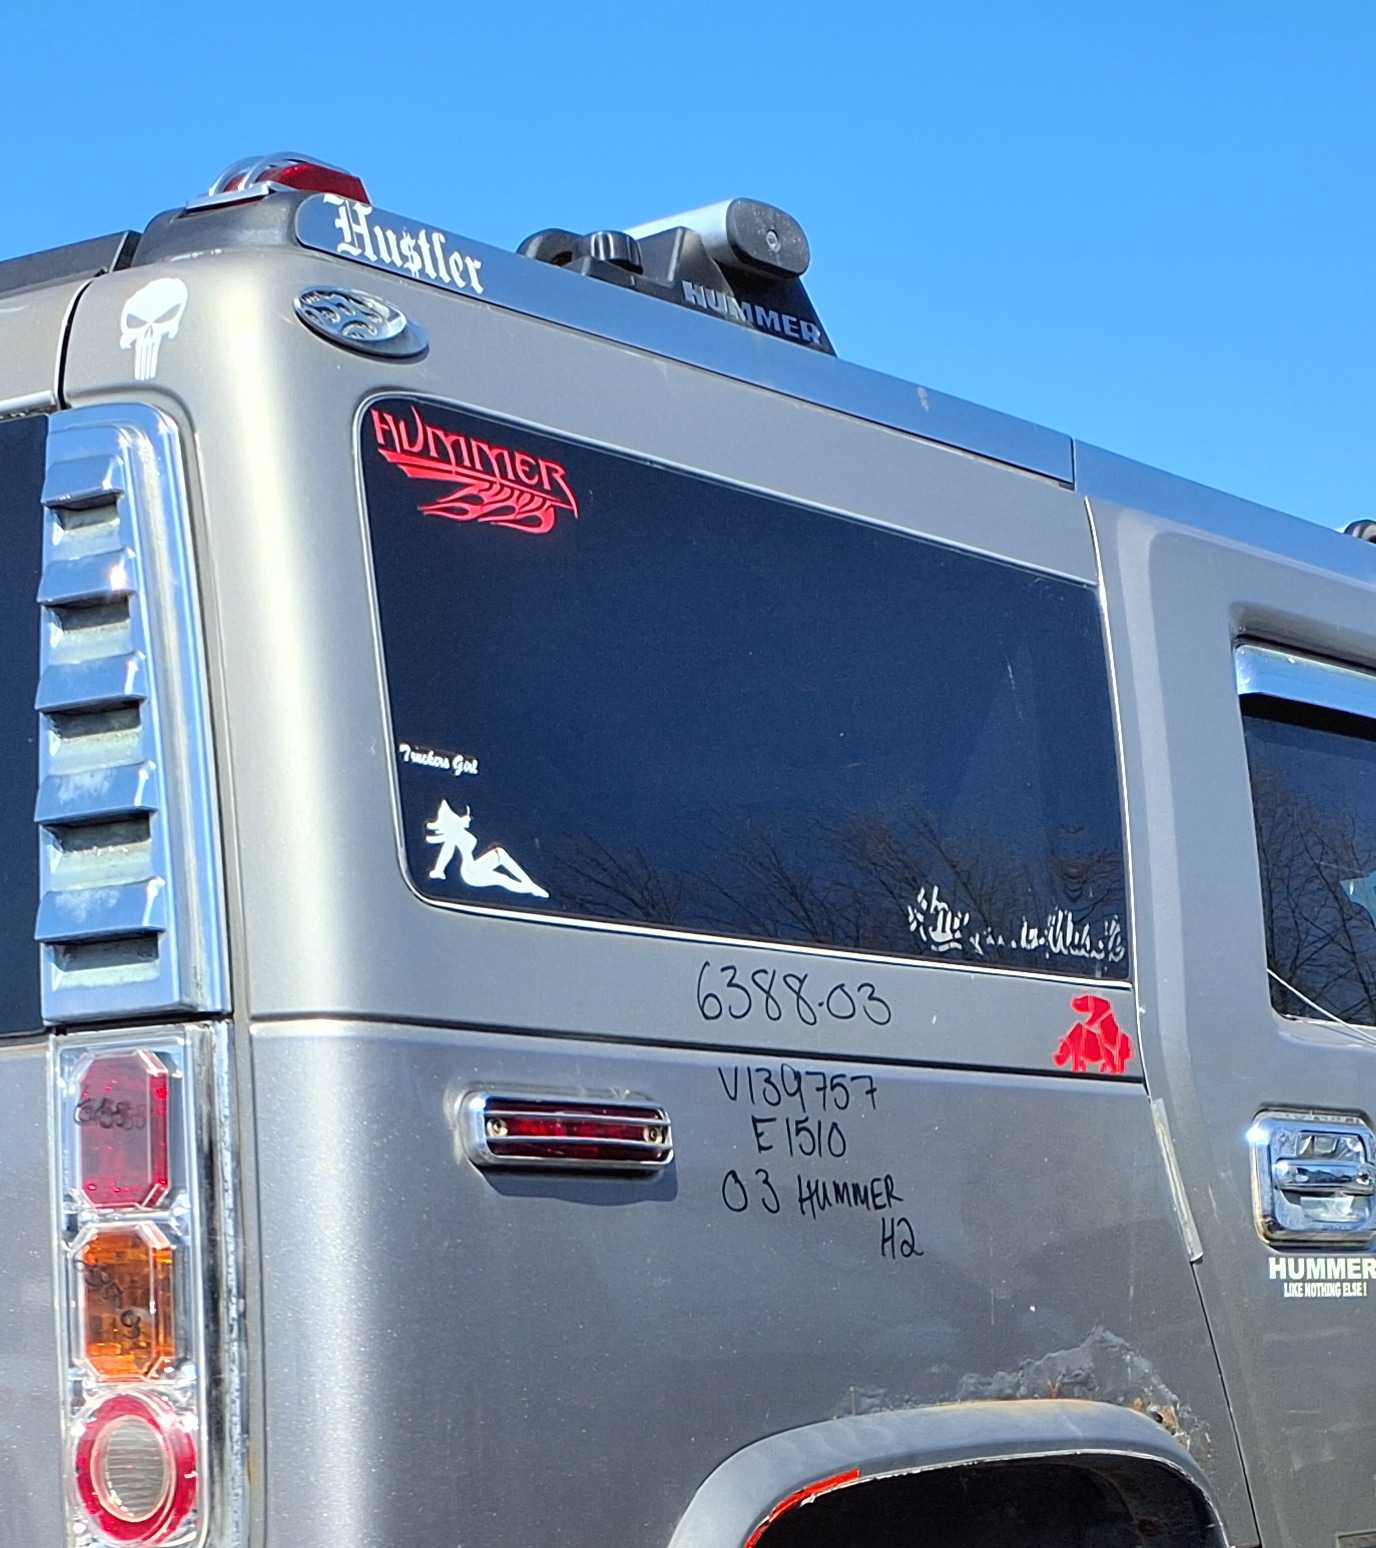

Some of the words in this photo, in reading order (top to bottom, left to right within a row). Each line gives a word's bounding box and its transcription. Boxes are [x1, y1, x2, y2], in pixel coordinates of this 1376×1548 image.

[681, 280, 821, 345] HUMMER
[371, 404, 580, 520] HUMMER
[717, 1063, 878, 1112] V139757
[797, 1173, 904, 1220] HUMMER
[880, 1217, 925, 1259] H2
[1283, 1282, 1304, 1298] LIKE
[1304, 1282, 1342, 1298] NOTHING
